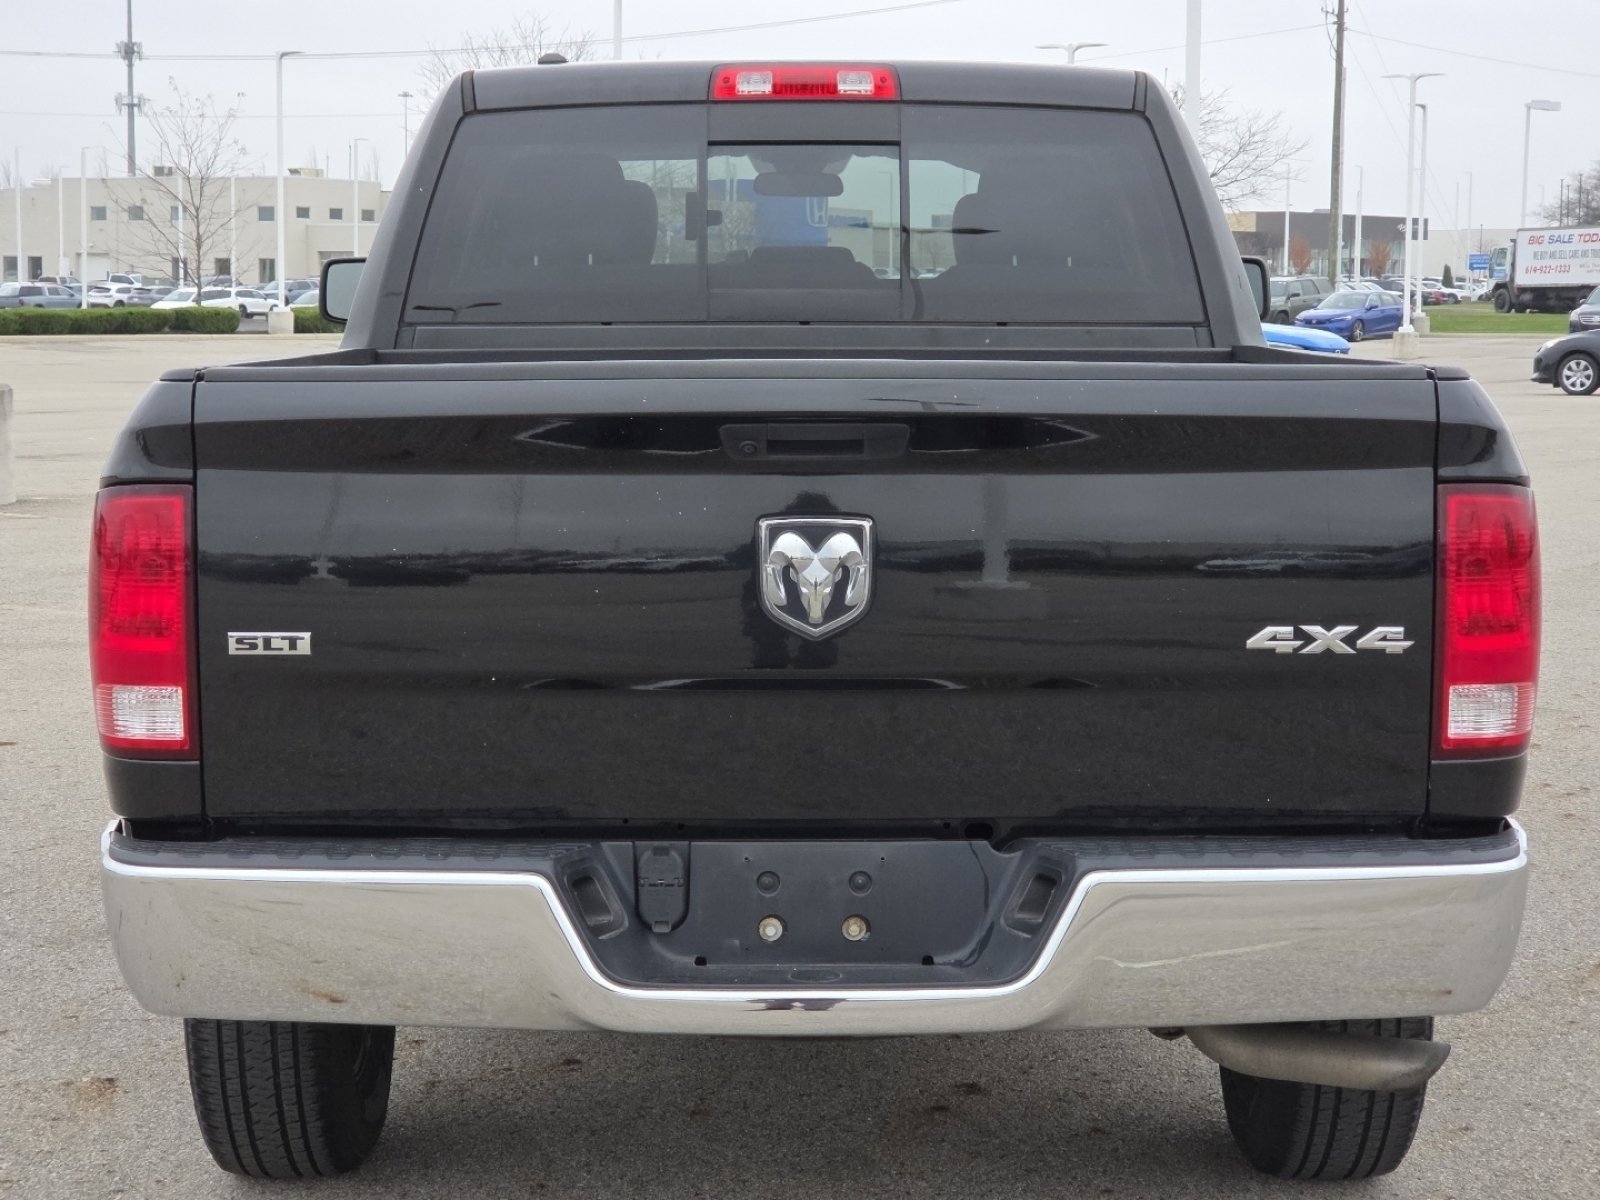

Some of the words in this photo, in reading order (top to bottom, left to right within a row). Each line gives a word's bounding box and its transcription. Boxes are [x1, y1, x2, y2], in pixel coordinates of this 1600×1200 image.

[1528, 235, 1544, 245] BIG
[1548, 234, 1575, 244] SALE
[231, 634, 308, 653] SLT
